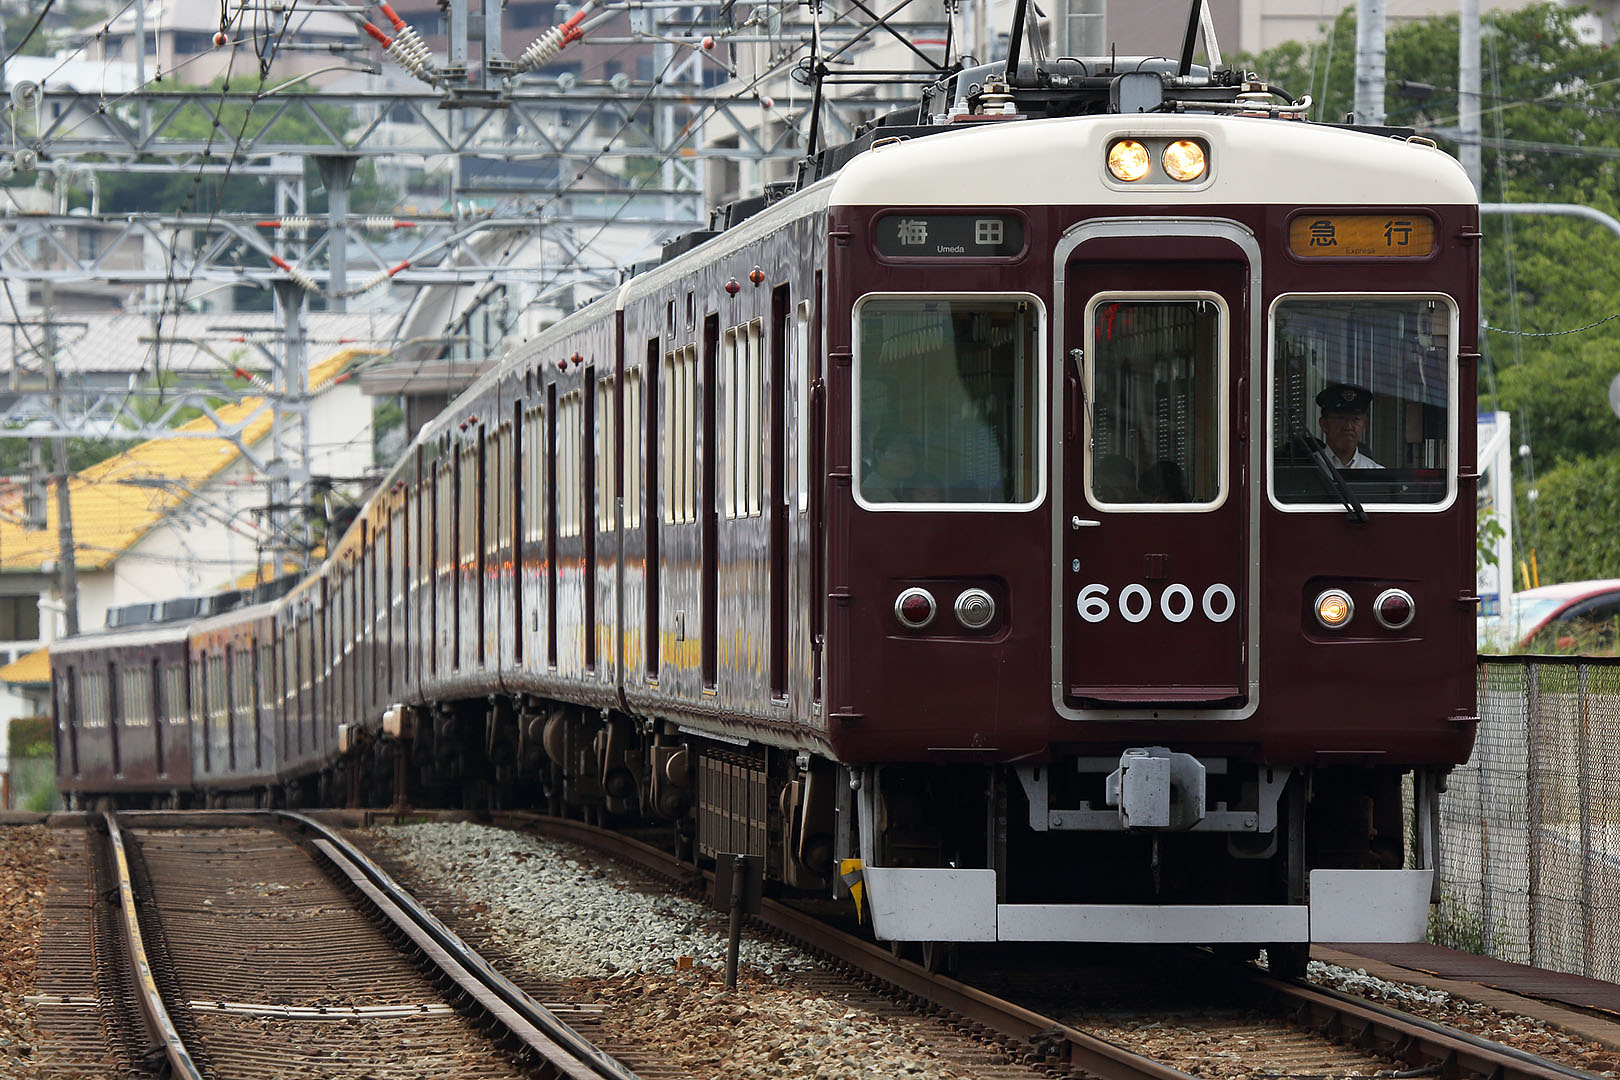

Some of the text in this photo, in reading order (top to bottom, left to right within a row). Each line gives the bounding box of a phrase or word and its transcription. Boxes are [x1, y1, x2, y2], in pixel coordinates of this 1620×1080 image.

[898, 219, 1004, 246] 梅田
[1309, 220, 1413, 247] 急行
[936, 245, 965, 253] Umeda
[1345, 247, 1376, 255] Express
[1076, 583, 1236, 623] 6000
